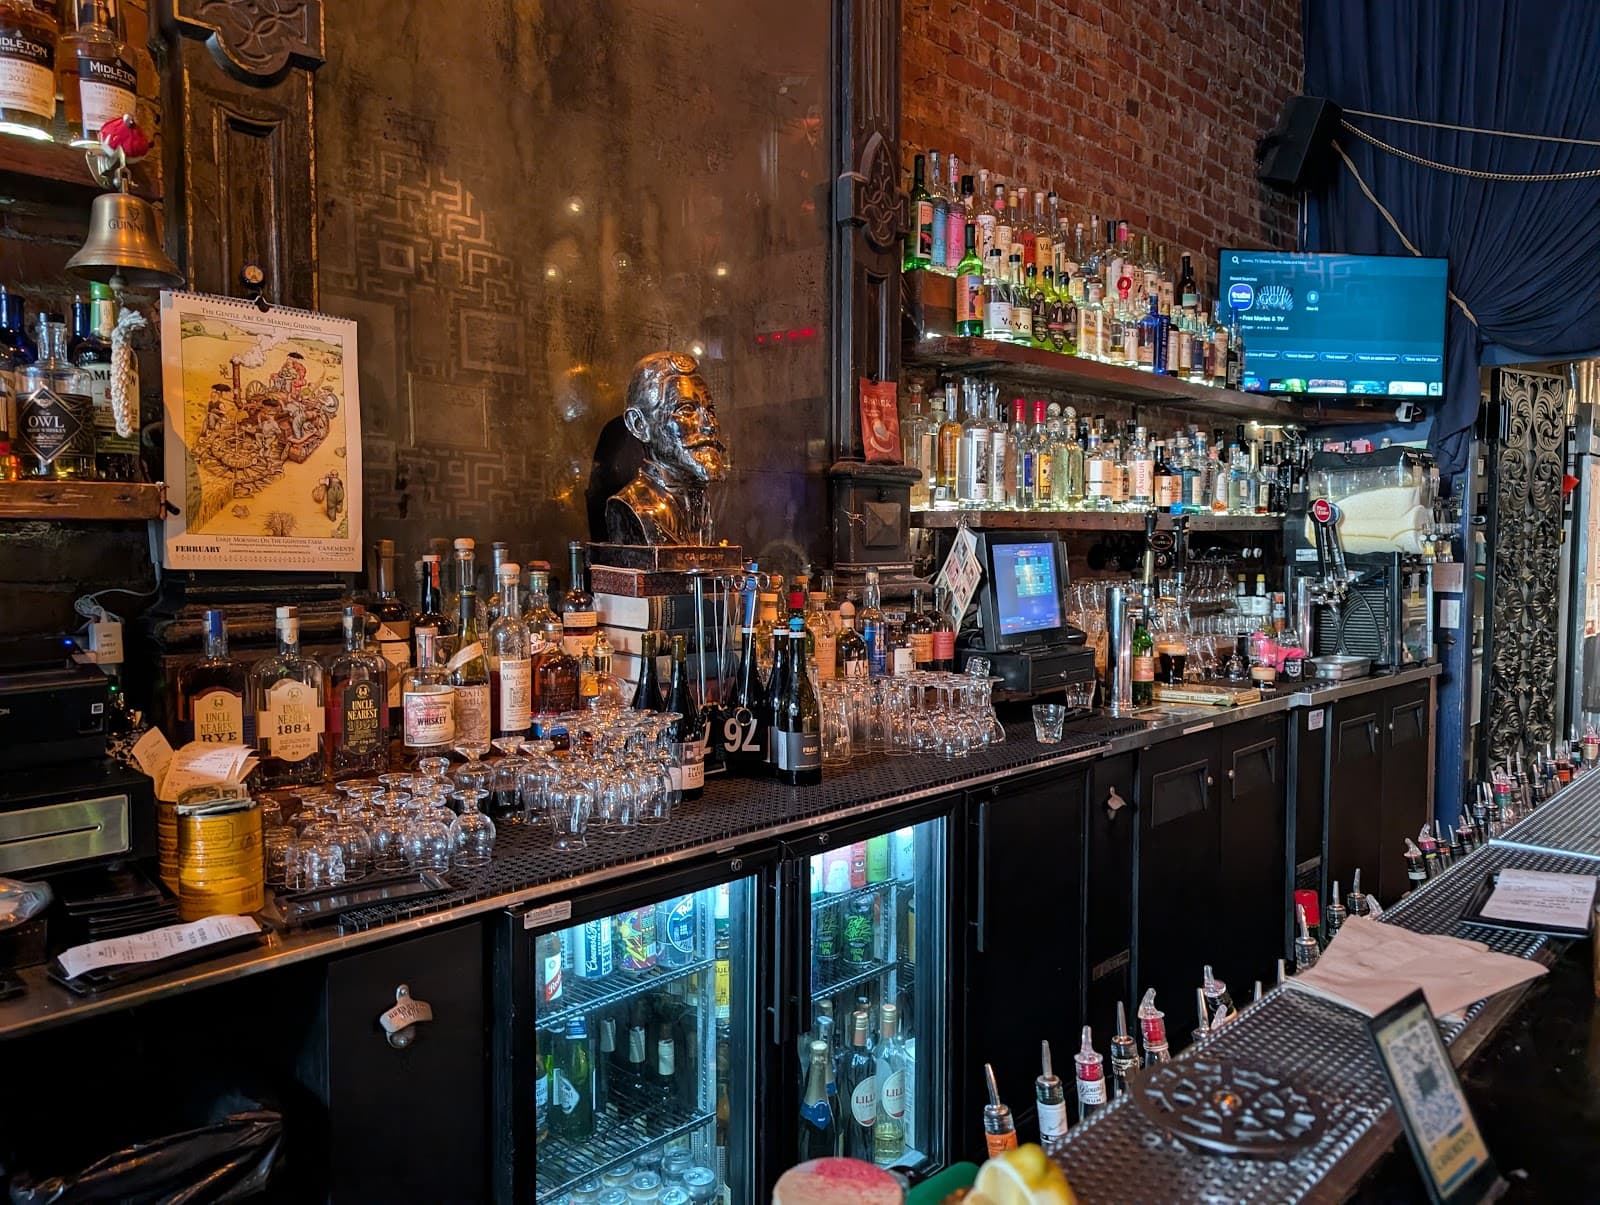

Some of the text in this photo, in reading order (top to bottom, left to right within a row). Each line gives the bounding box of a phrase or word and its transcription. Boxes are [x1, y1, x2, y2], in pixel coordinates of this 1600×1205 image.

[28, 415, 65, 428] OWL
[175, 545, 221, 553] FEBRUARY
[351, 699, 374, 711] UNCLE
[347, 709, 378, 721] NEAREST
[417, 716, 446, 726] WHISKEY
[277, 723, 312, 735] 1884
[201, 732, 237, 742] RYE
